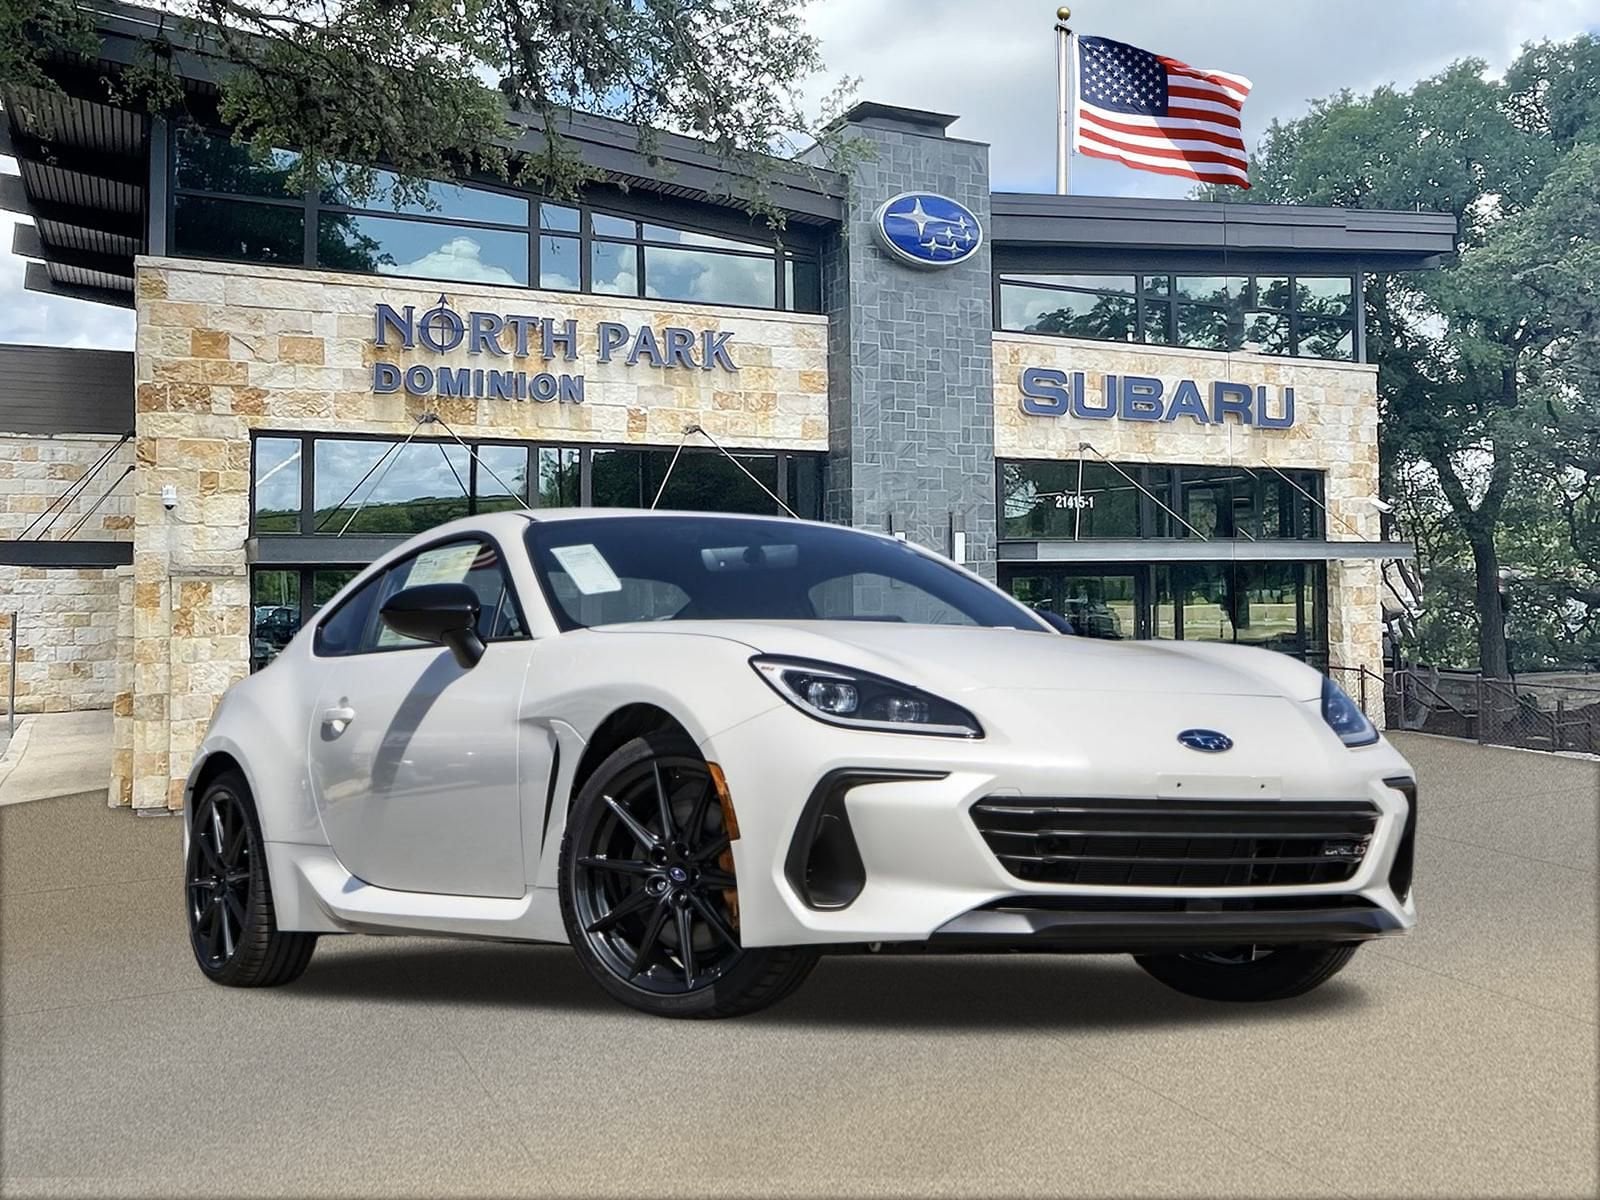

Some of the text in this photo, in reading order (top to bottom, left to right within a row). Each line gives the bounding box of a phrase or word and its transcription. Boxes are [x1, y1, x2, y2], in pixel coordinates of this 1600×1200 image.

[374, 298, 739, 372] NORTH PARK
[373, 362, 585, 404] DOMINION
[1018, 367, 1295, 429] SUBARU
